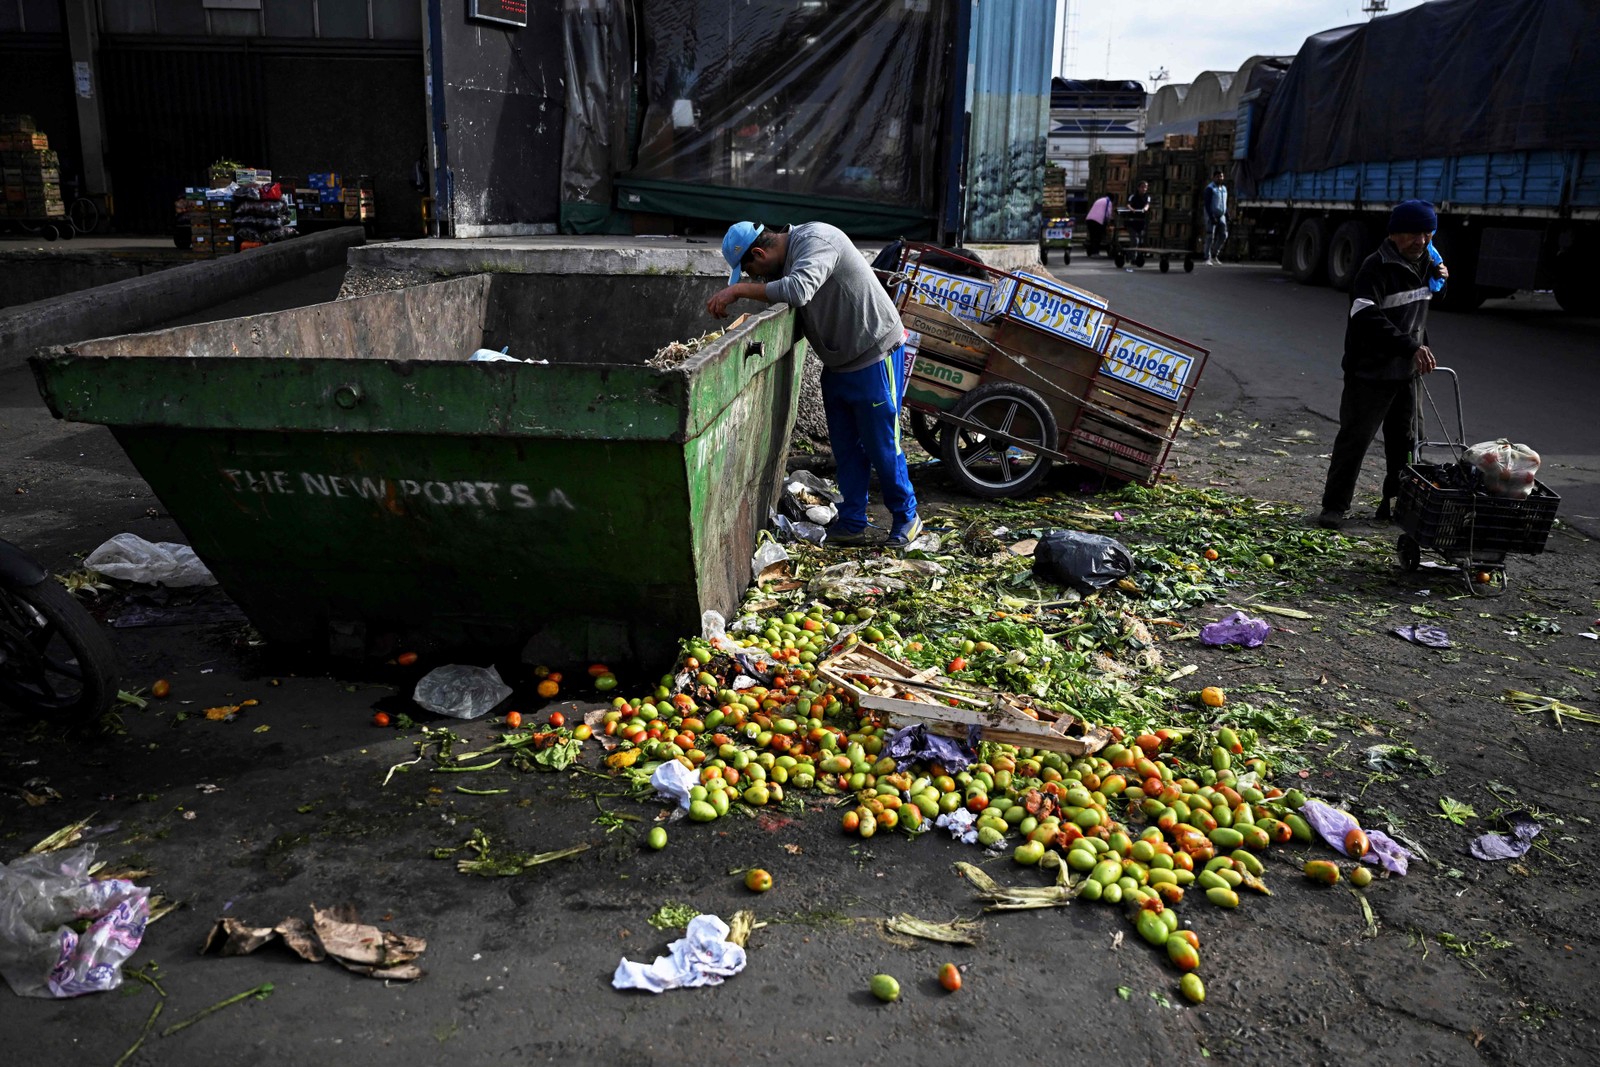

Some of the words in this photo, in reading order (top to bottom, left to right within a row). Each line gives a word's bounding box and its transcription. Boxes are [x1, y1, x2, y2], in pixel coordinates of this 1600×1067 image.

[920, 283, 971, 310] Bolita
[1029, 291, 1084, 326] Bolita
[1068, 327, 1091, 342] Bananas
[1117, 347, 1169, 381] Bolita
[222, 468, 295, 494] THE
[300, 471, 387, 499] NEW
